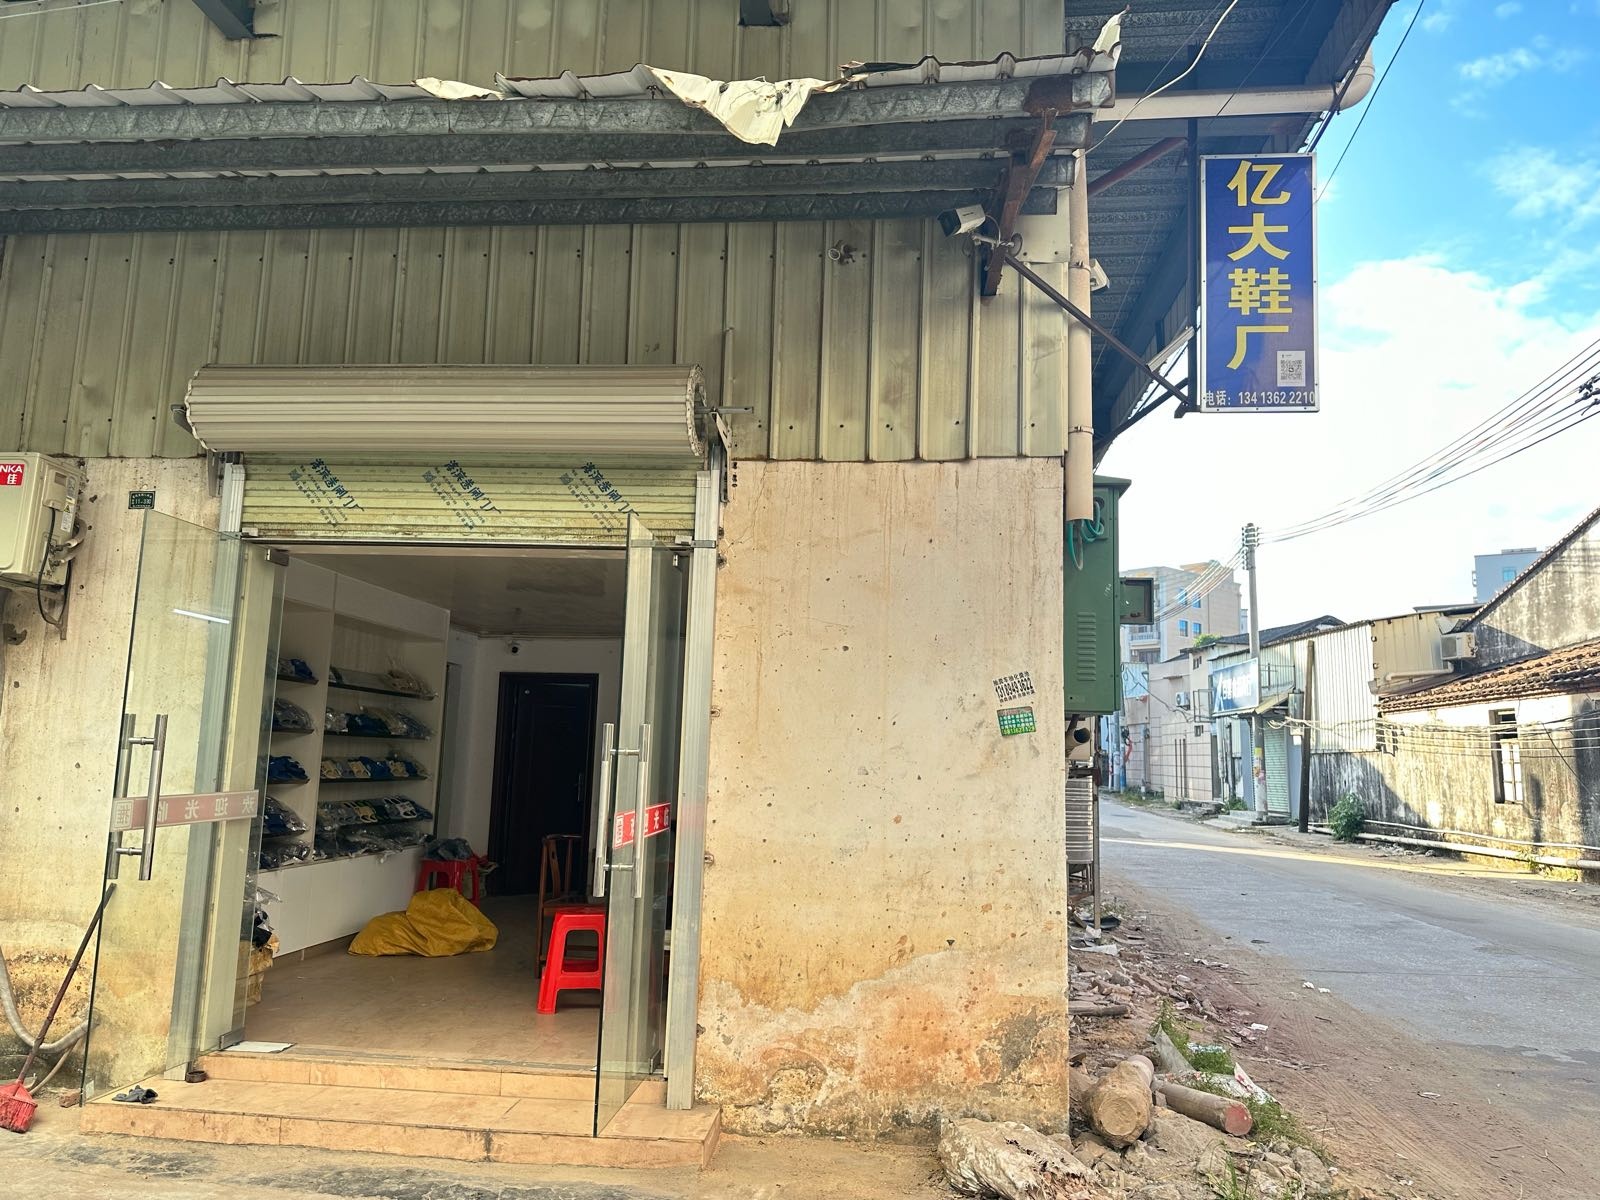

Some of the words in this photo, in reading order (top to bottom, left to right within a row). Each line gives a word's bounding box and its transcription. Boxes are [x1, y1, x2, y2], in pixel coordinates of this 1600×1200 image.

[1226, 159, 1292, 370] 亿大鞋厂
[1238, 391, 1257, 404] 134
[1260, 391, 1286, 404] 1362
[1289, 391, 1315, 404] 2210
